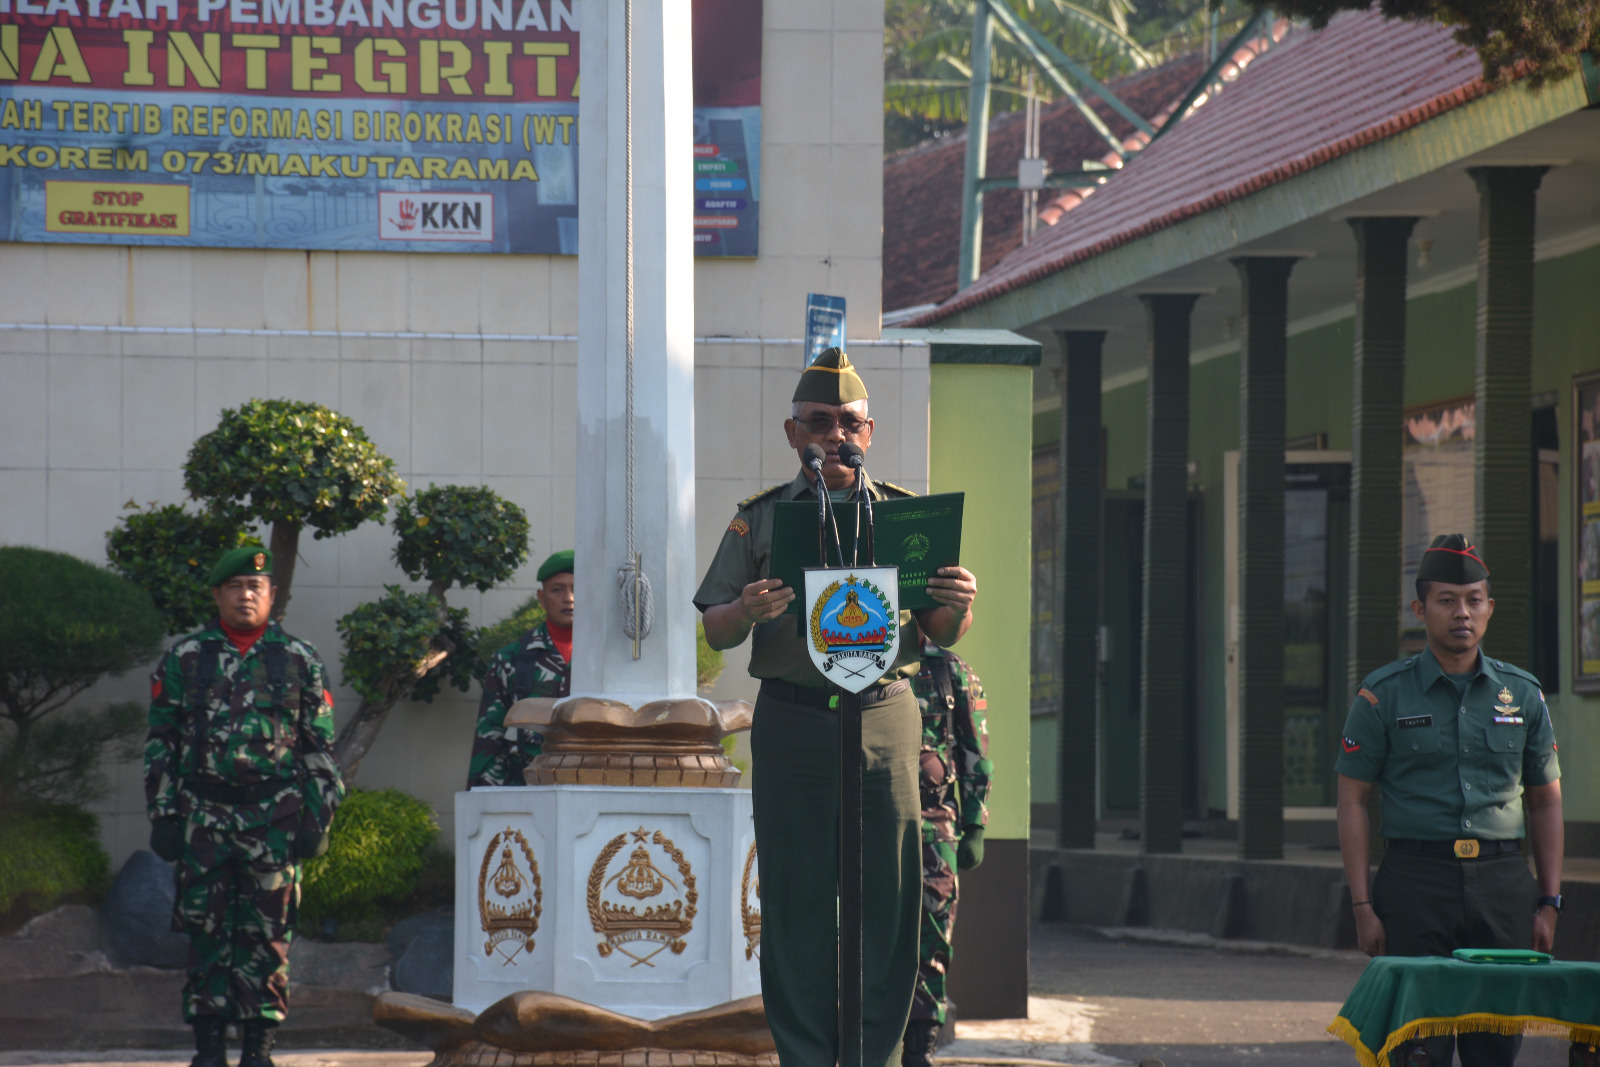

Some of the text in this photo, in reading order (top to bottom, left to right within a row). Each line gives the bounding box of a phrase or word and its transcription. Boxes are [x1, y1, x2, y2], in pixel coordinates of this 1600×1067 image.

[197, 0, 580, 33] PEMBANGUNAN
[122, 29, 580, 98] INTEGRIT
[52, 100, 162, 135] TERTIB
[172, 105, 343, 141] REFORMASI
[353, 110, 513, 144] BIROKRASI
[522, 114, 580, 152] (WT
[0, 144, 540, 182] KOREM 073/MAKUTARAMA
[92, 190, 144, 207] STOP
[58, 210, 178, 229] GRATIFIKASI
[422, 202, 482, 231] KKN
